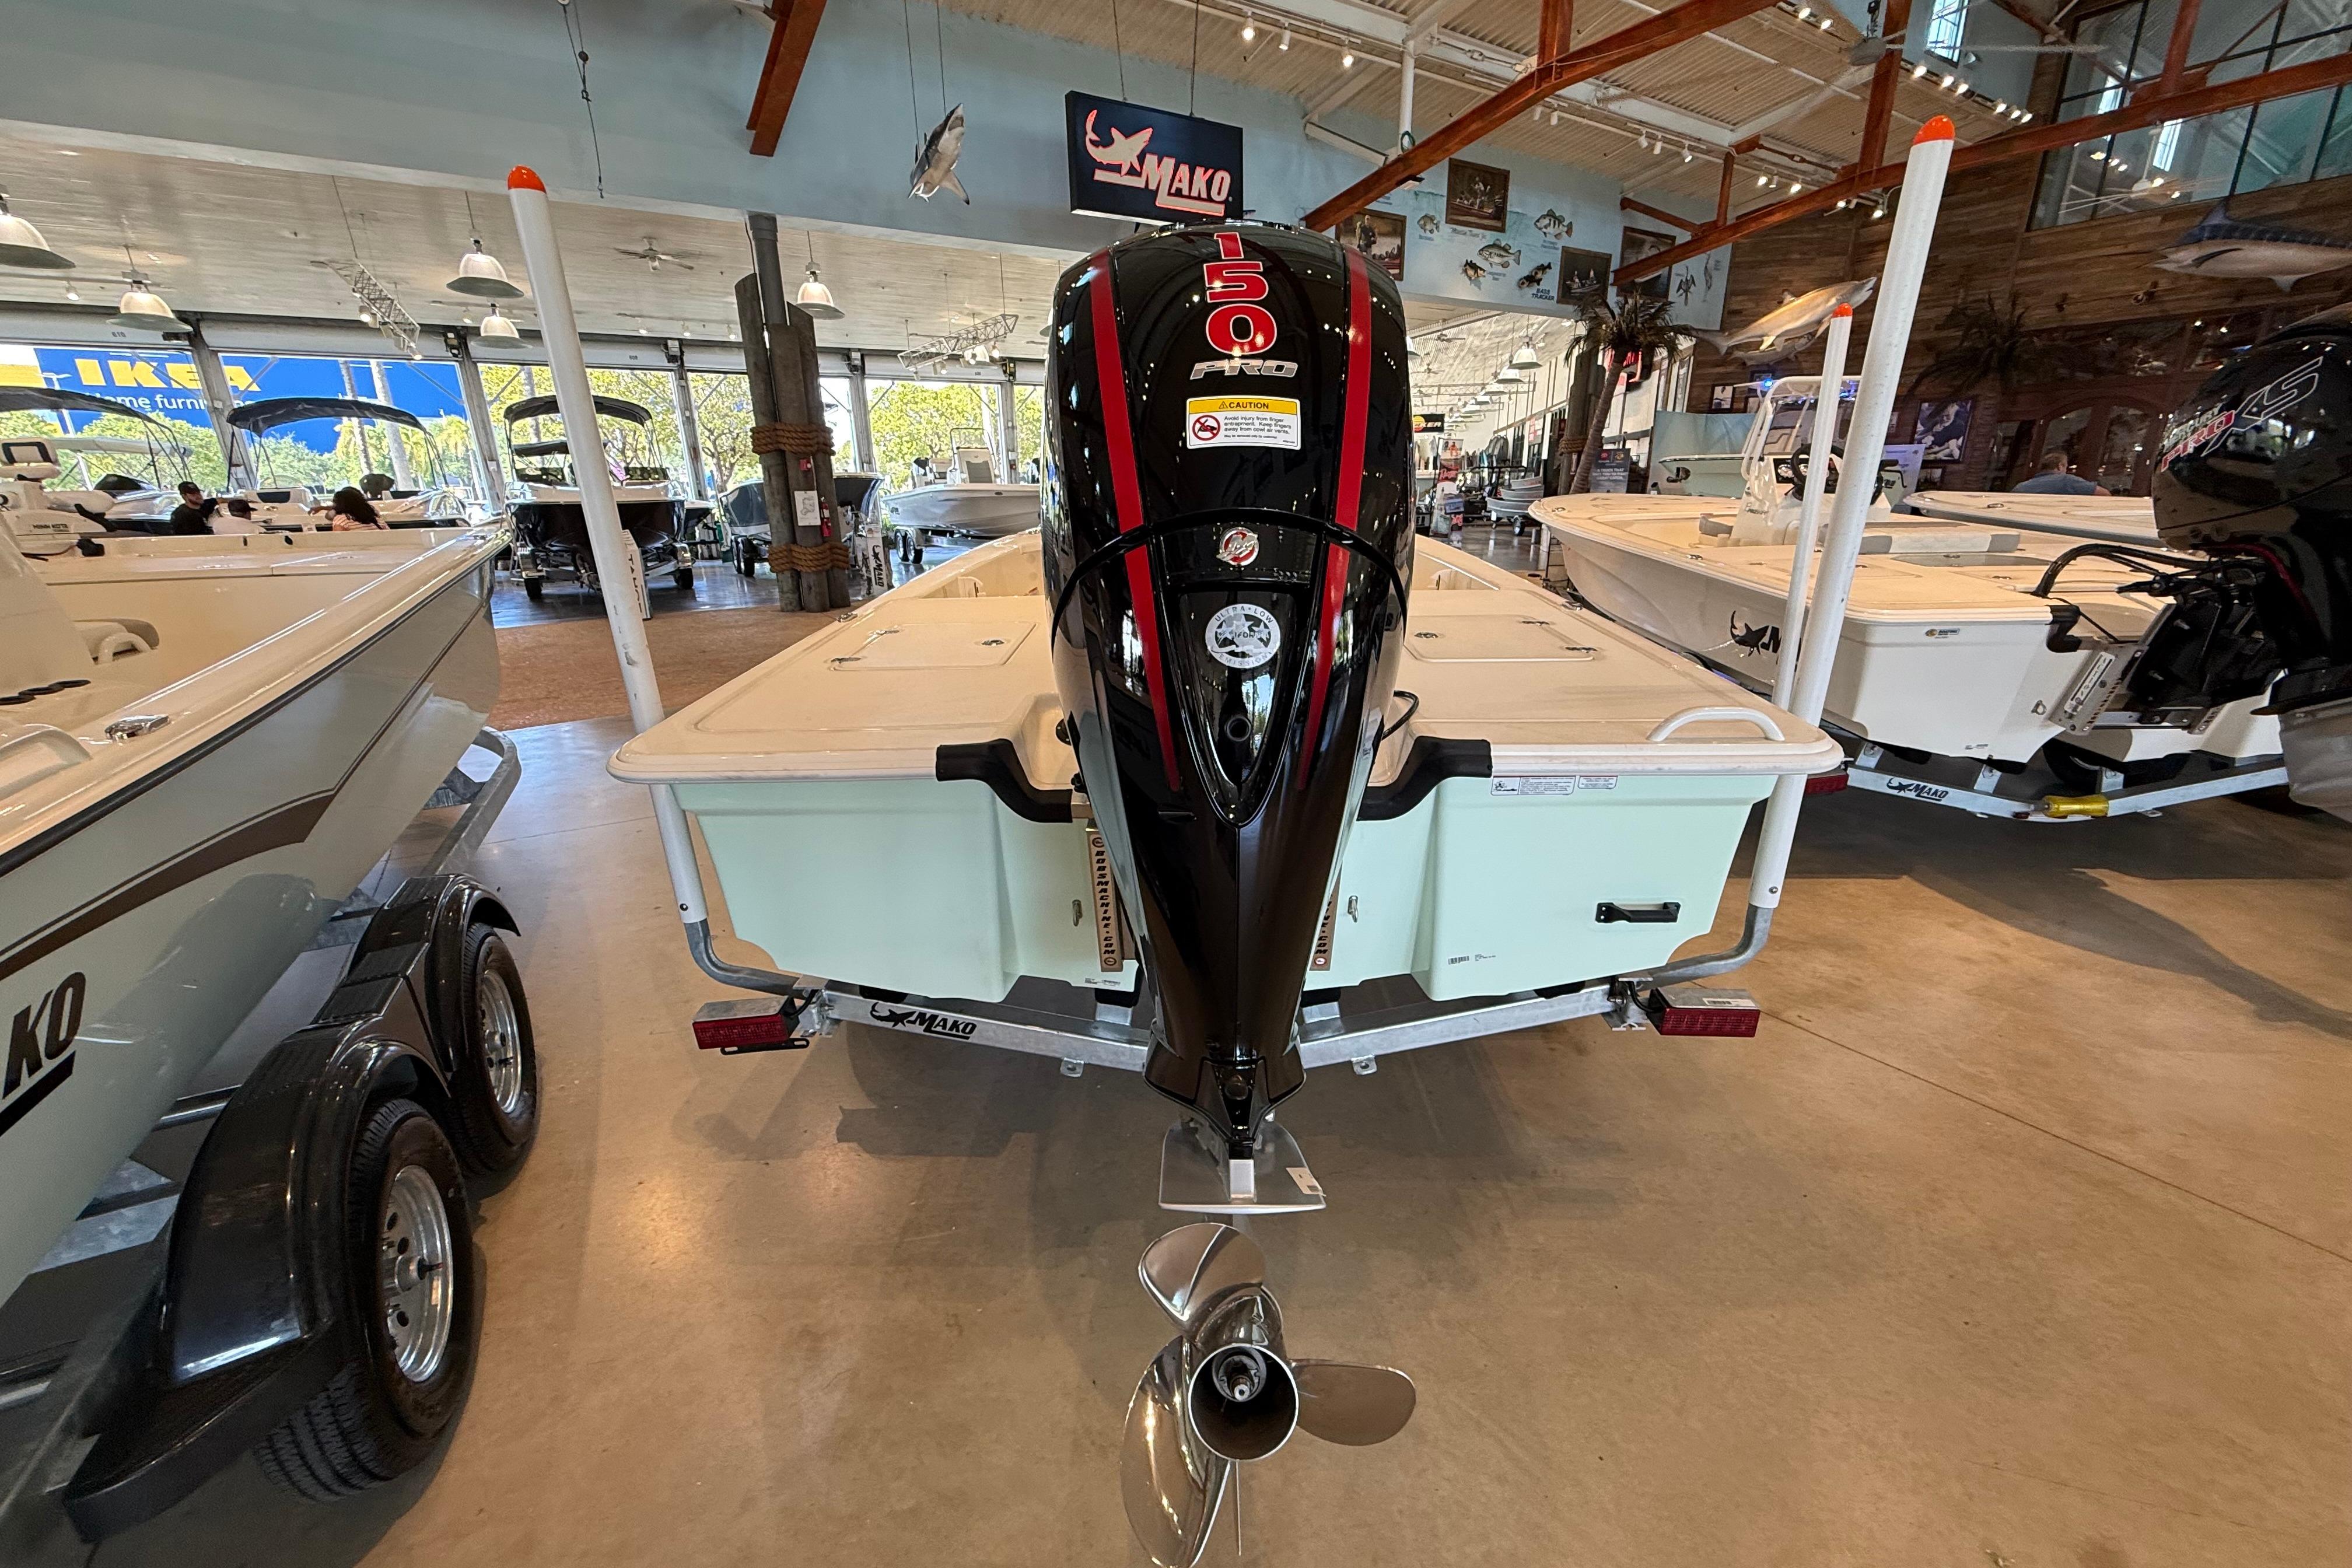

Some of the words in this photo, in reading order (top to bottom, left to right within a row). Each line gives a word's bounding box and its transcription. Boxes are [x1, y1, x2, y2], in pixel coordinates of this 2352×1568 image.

[1139, 153, 1232, 216] MAKO
[1203, 232, 1278, 355] 150
[1532, 293, 1555, 301] TRACKER
[75, 358, 261, 391] IKEA
[1190, 359, 1298, 379] PRO
[1228, 401, 1269, 410] CAUTION
[2161, 410, 2236, 473] PRO
[2200, 356, 2324, 457] XS
[1907, 783, 1950, 802] MAKO
[2, 971, 86, 1100] KO
[906, 1012, 977, 1040] MAKO
